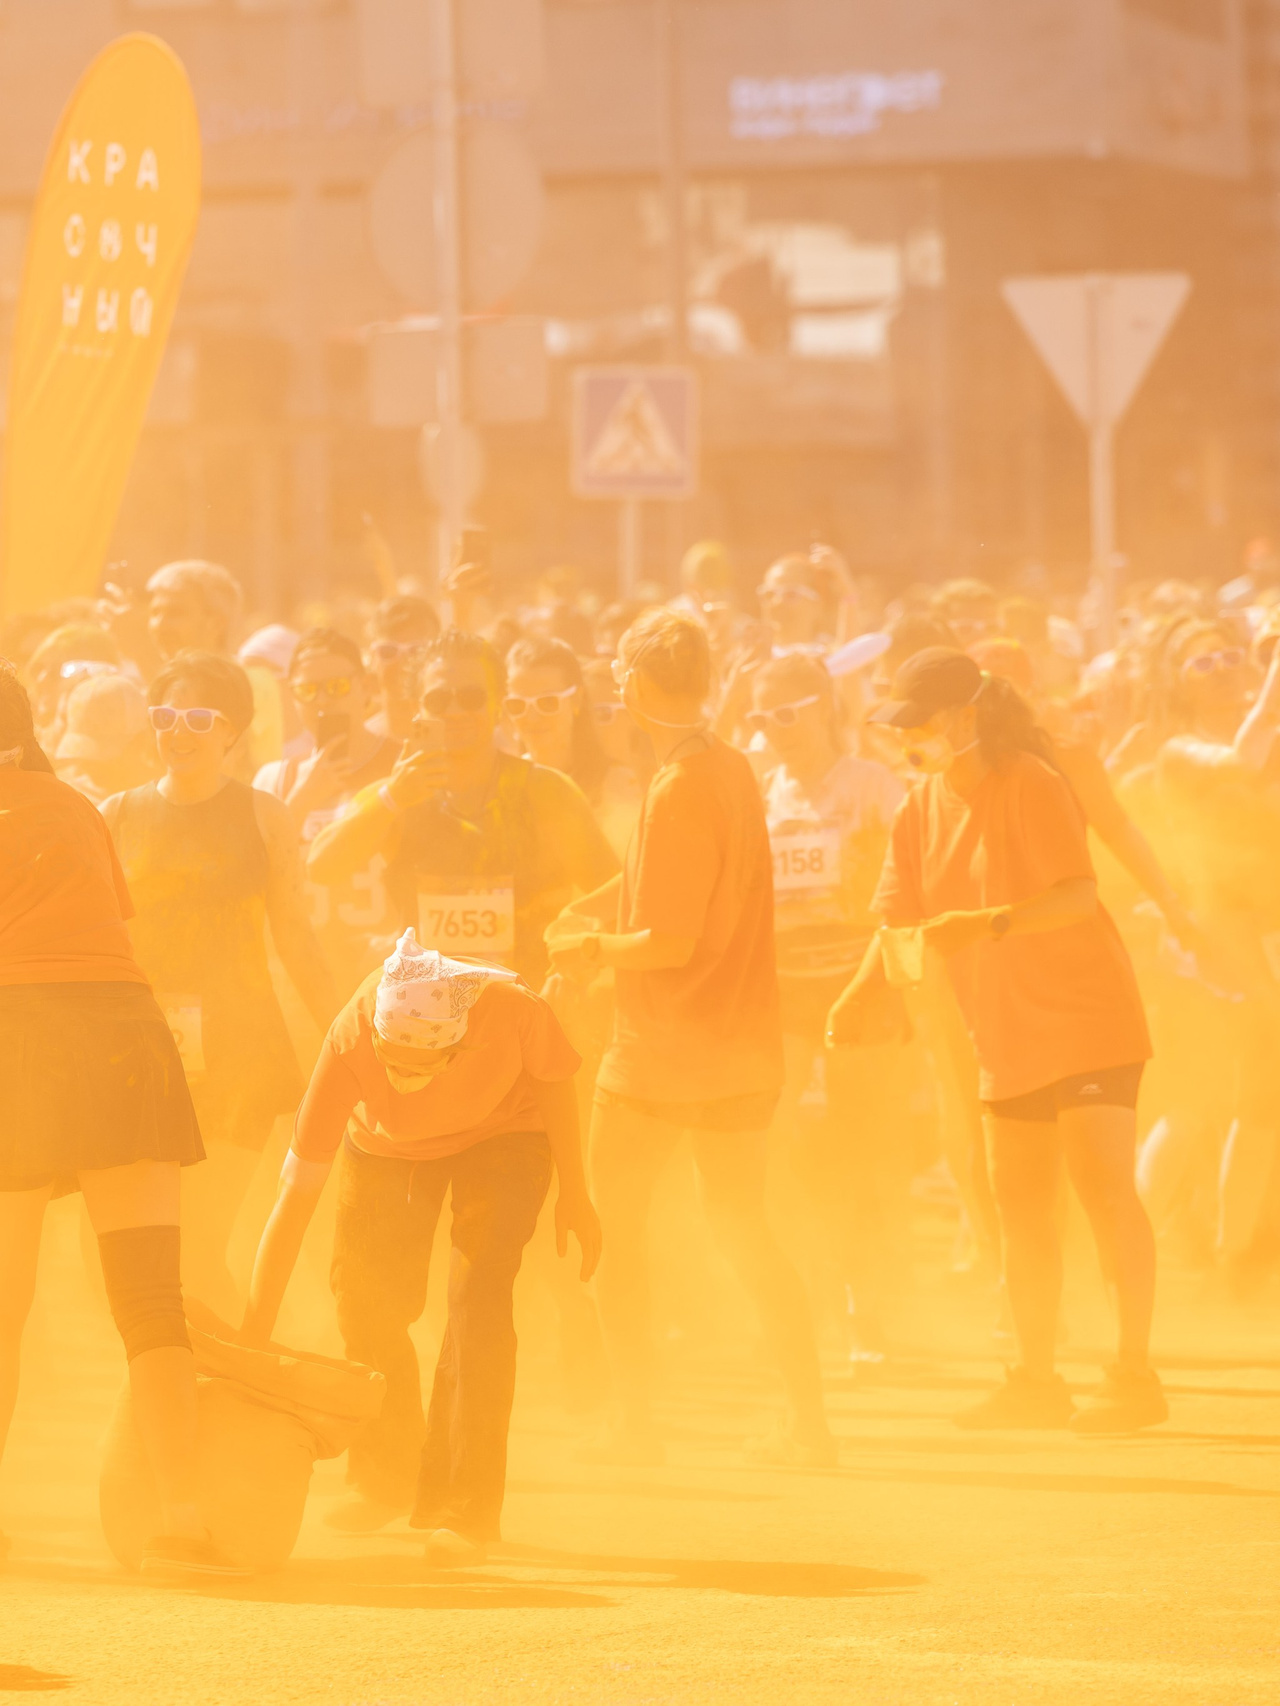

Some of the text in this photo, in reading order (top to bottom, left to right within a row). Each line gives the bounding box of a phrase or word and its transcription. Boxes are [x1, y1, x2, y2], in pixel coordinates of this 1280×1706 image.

[67, 139, 160, 192] КРА
[771, 847, 824, 877] 158
[427, 909, 498, 939] 7653
